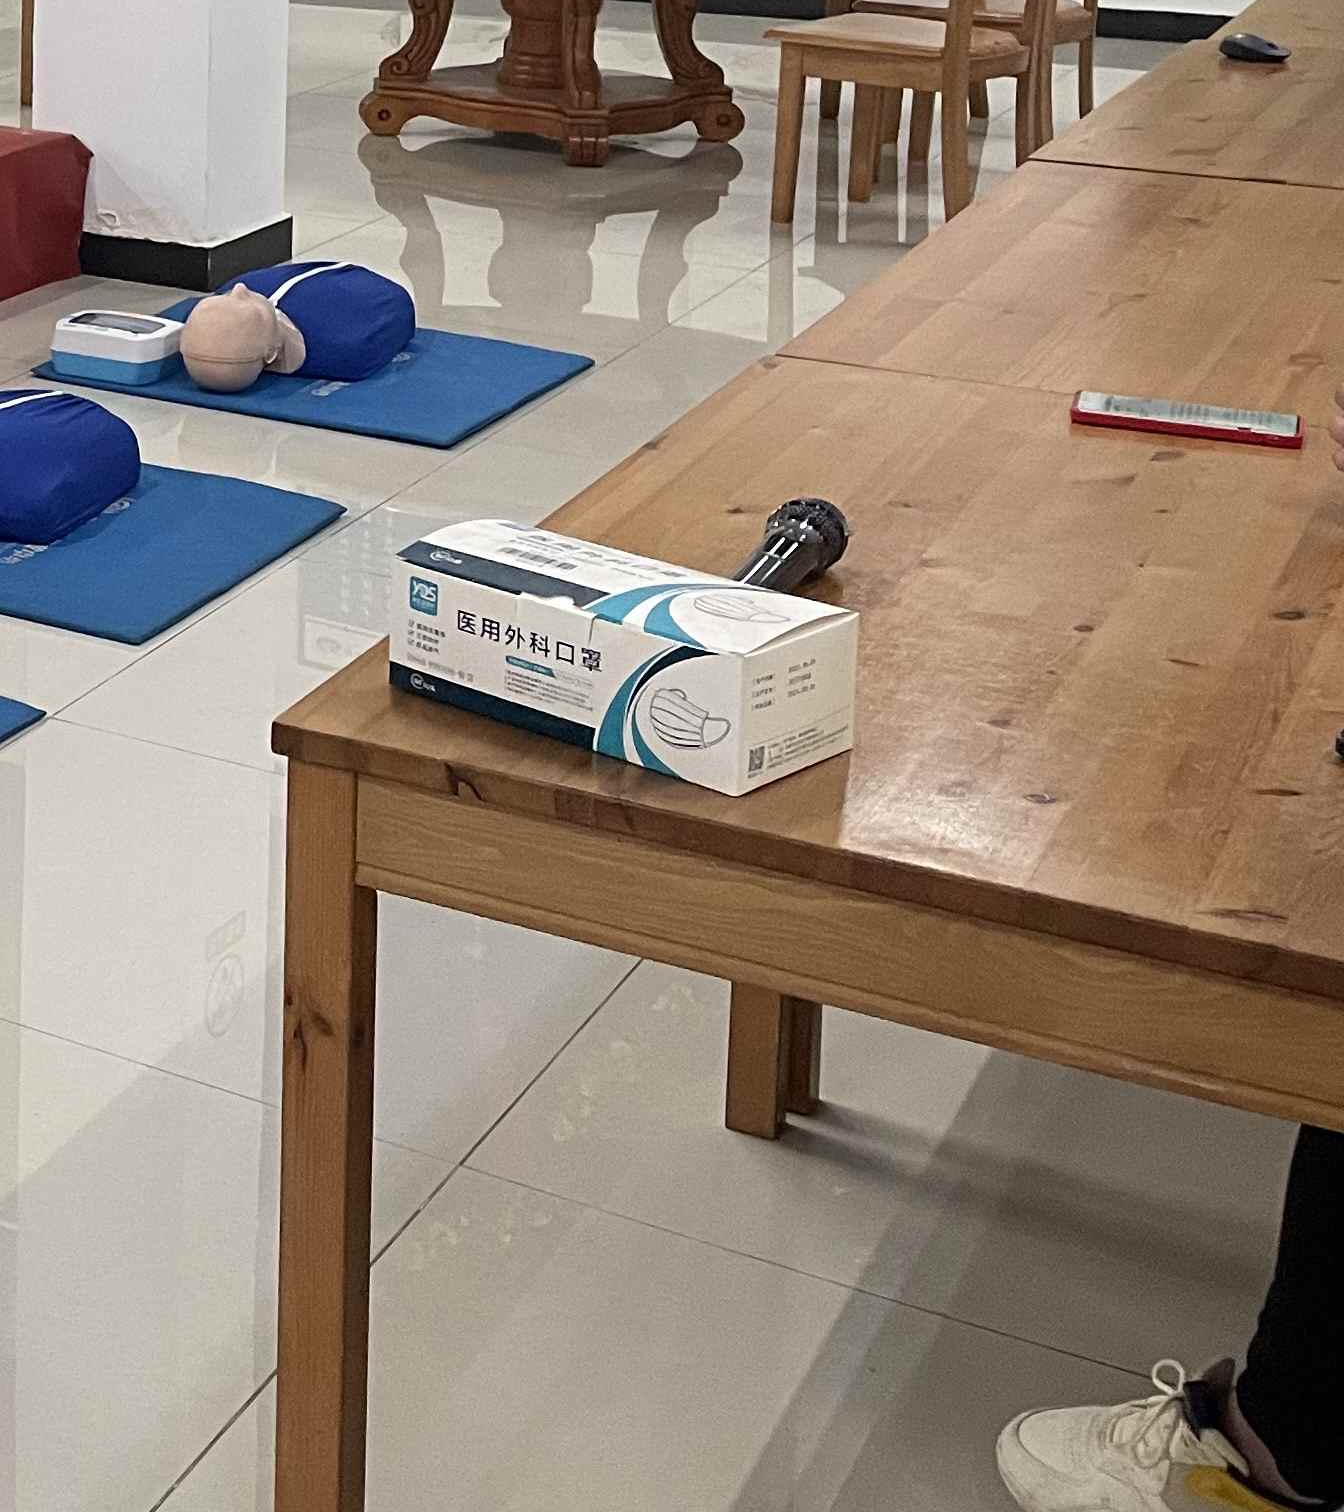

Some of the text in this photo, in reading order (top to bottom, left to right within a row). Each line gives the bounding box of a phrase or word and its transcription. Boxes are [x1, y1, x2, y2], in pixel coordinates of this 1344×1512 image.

[457, 609, 602, 672] 医用外科口罩
